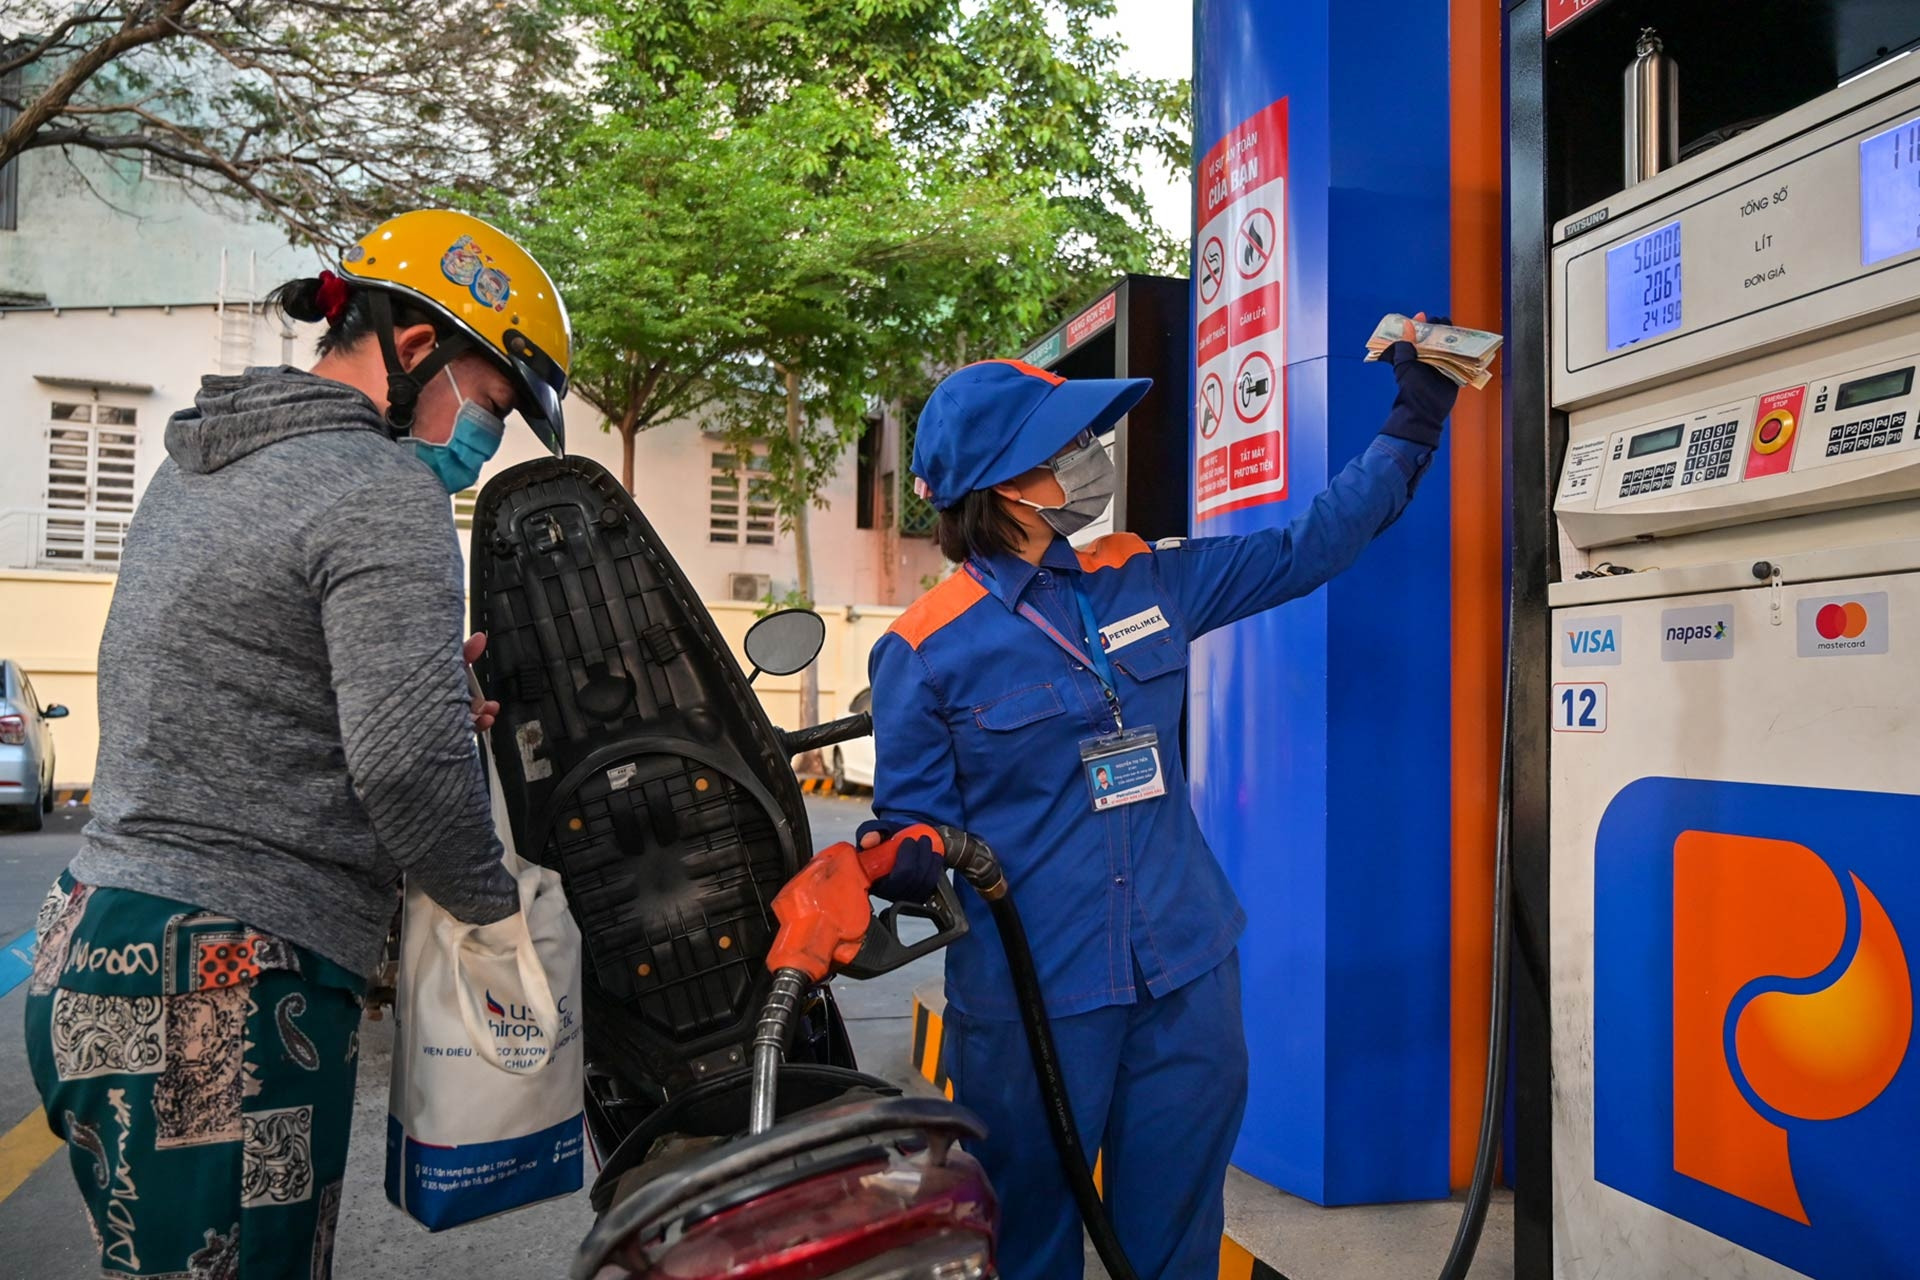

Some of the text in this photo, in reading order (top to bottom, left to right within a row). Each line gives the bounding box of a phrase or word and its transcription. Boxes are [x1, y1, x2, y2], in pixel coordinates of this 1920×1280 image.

[1209, 157, 1258, 210] CỦA BẠN
[1566, 210, 1607, 236] TATSUNO
[1754, 233, 1773, 252] LÍT
[1744, 264, 1786, 288] ĐƠN GIÁ
[1643, 300, 1682, 332] 24190
[1773, 400, 1788, 408] STOP
[1831, 415, 1904, 438] P1 P2 P3 P4 P5
[1828, 432, 1901, 454] P6 P7 P8 P9 P10
[1108, 614, 1162, 641] PETROLIMEX
[1666, 623, 1712, 644] napas
[1567, 629, 1616, 654] VISA
[1818, 639, 1866, 650] mastercard
[1561, 688, 1597, 727] 12
